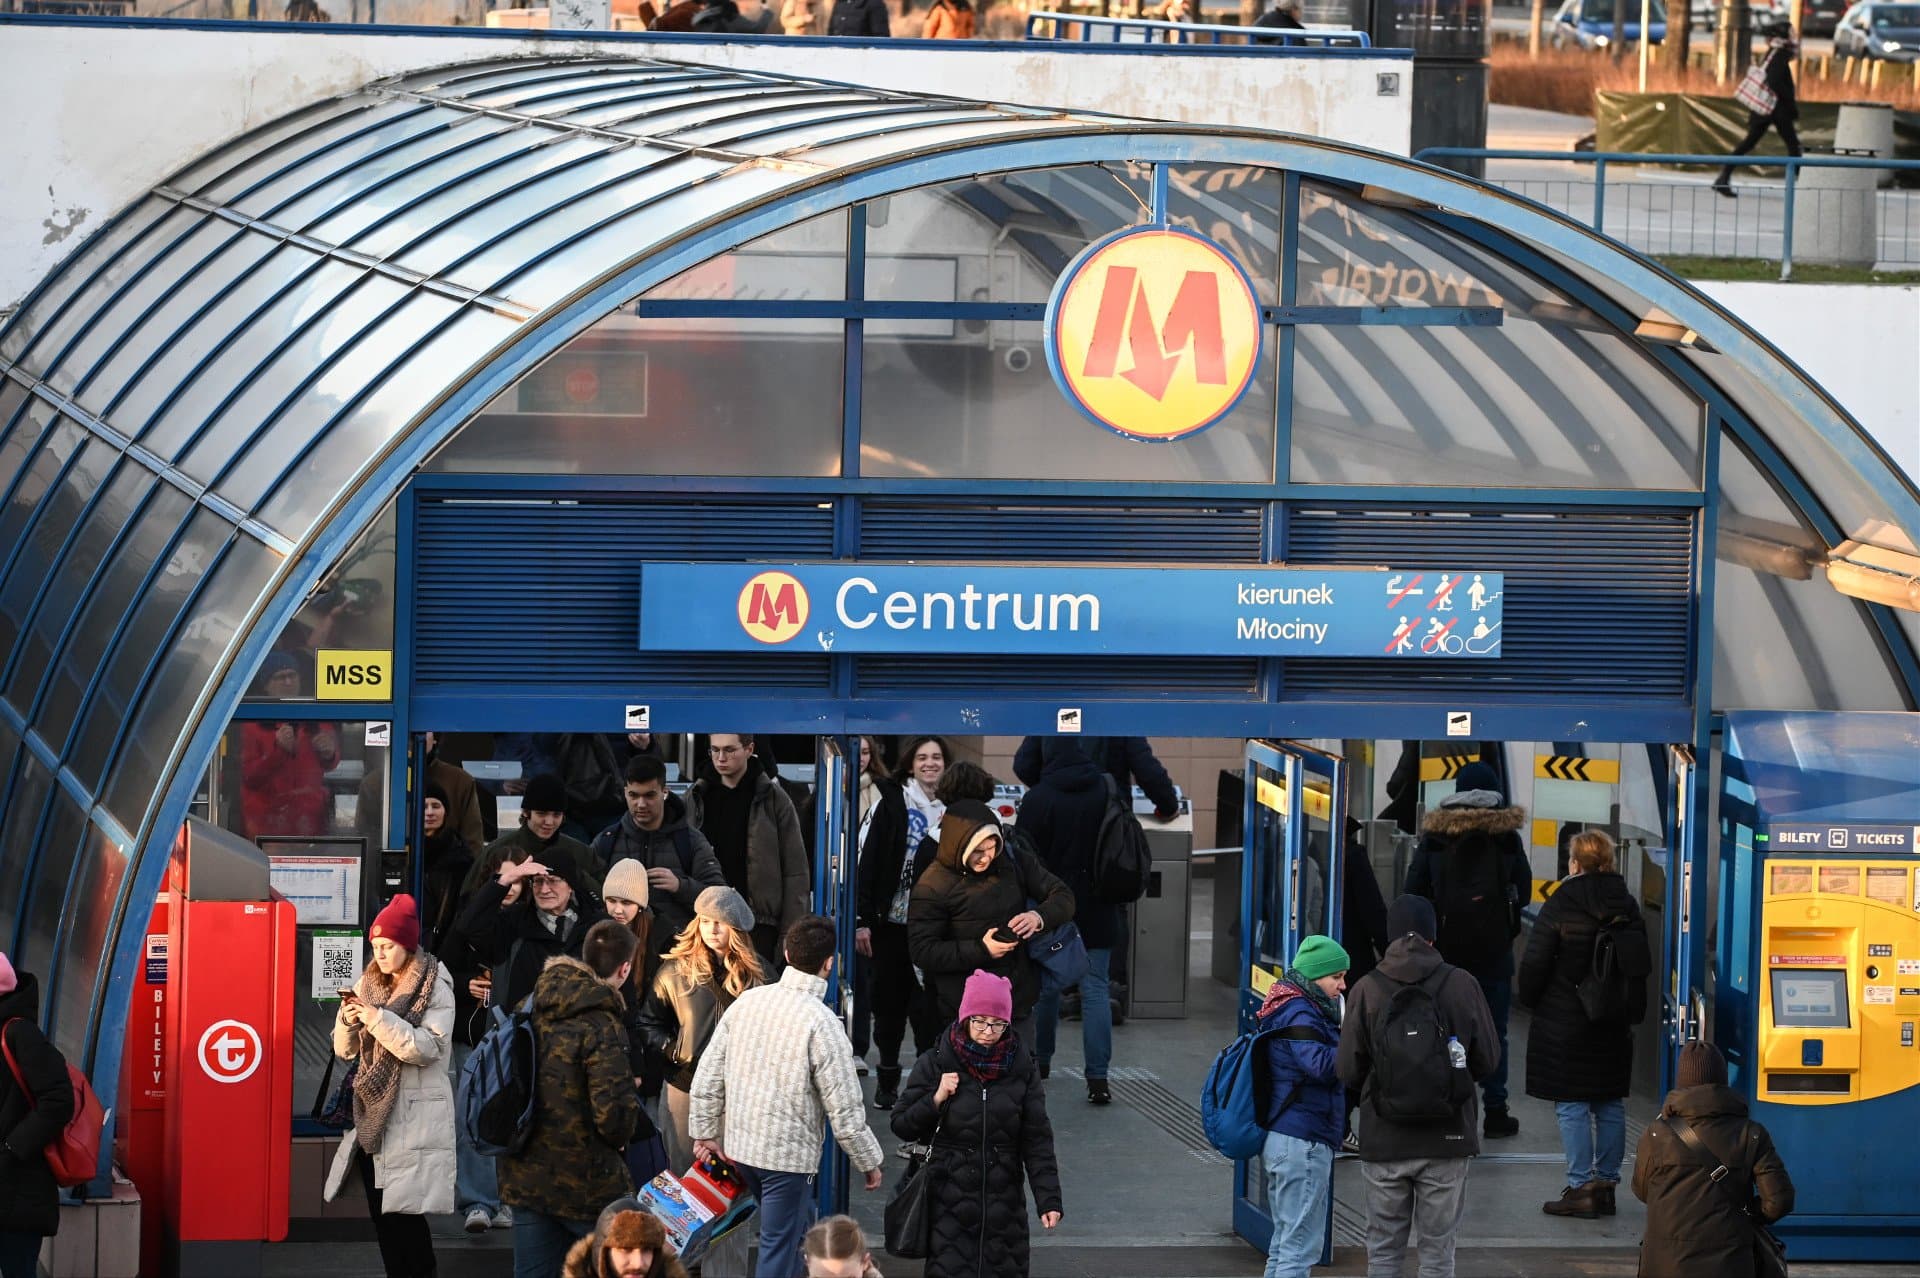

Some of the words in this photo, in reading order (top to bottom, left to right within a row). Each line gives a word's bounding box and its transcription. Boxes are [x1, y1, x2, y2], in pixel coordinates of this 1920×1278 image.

[835, 577, 1100, 631] Centrum
[1237, 583, 1334, 606] kierunek
[1237, 616, 1328, 645] Młociny
[326, 665, 382, 685] MSS
[1778, 831, 1821, 845] BILETY
[1855, 833, 1905, 846] TICKETS
[153, 989, 163, 1084] BILETY
